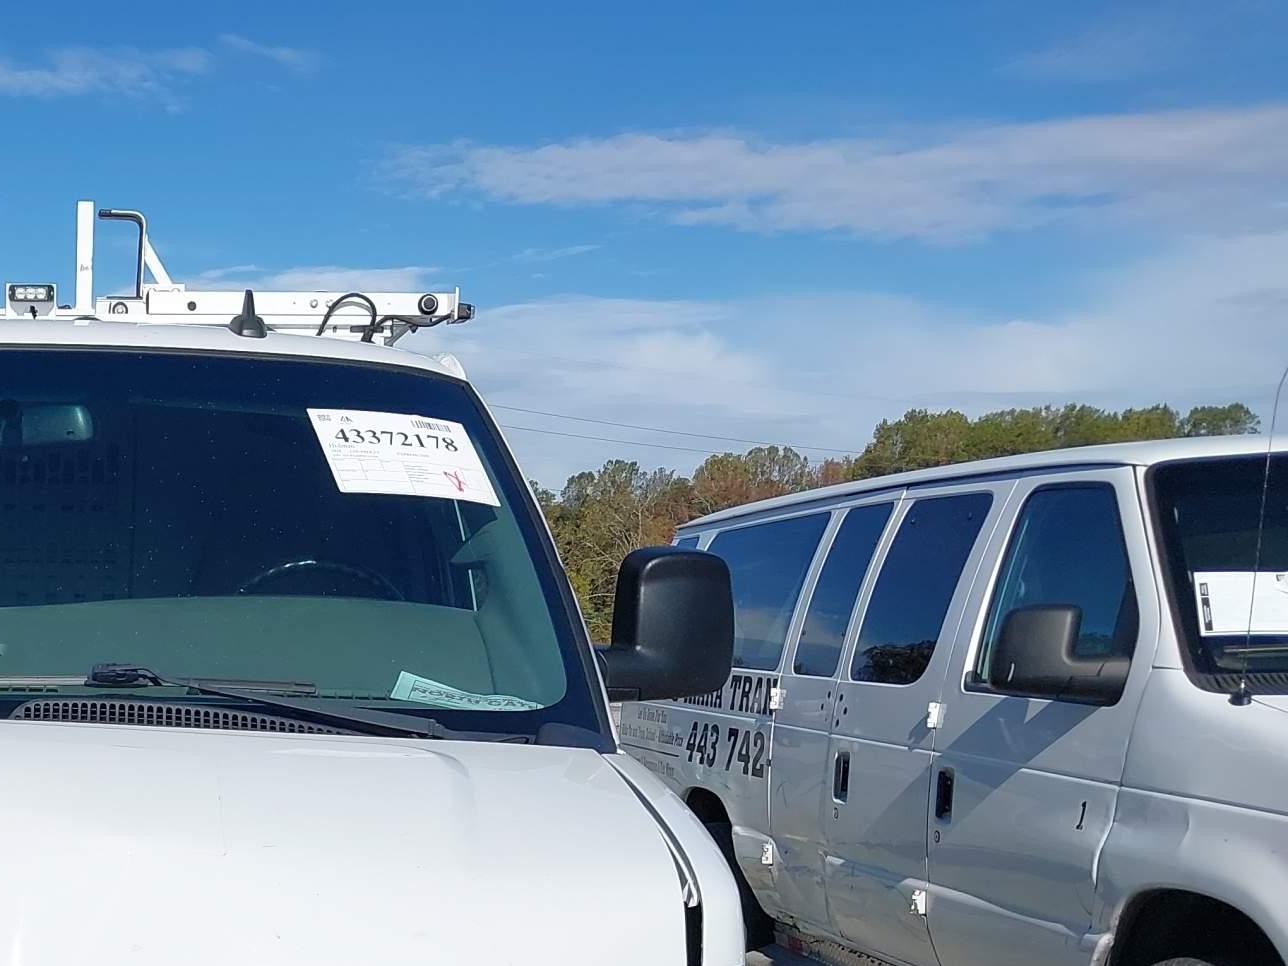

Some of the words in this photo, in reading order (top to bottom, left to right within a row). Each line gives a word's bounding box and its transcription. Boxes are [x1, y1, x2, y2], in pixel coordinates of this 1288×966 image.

[334, 428, 458, 453] 43372178
[685, 721, 720, 768] 443
[724, 727, 765, 779] 742
